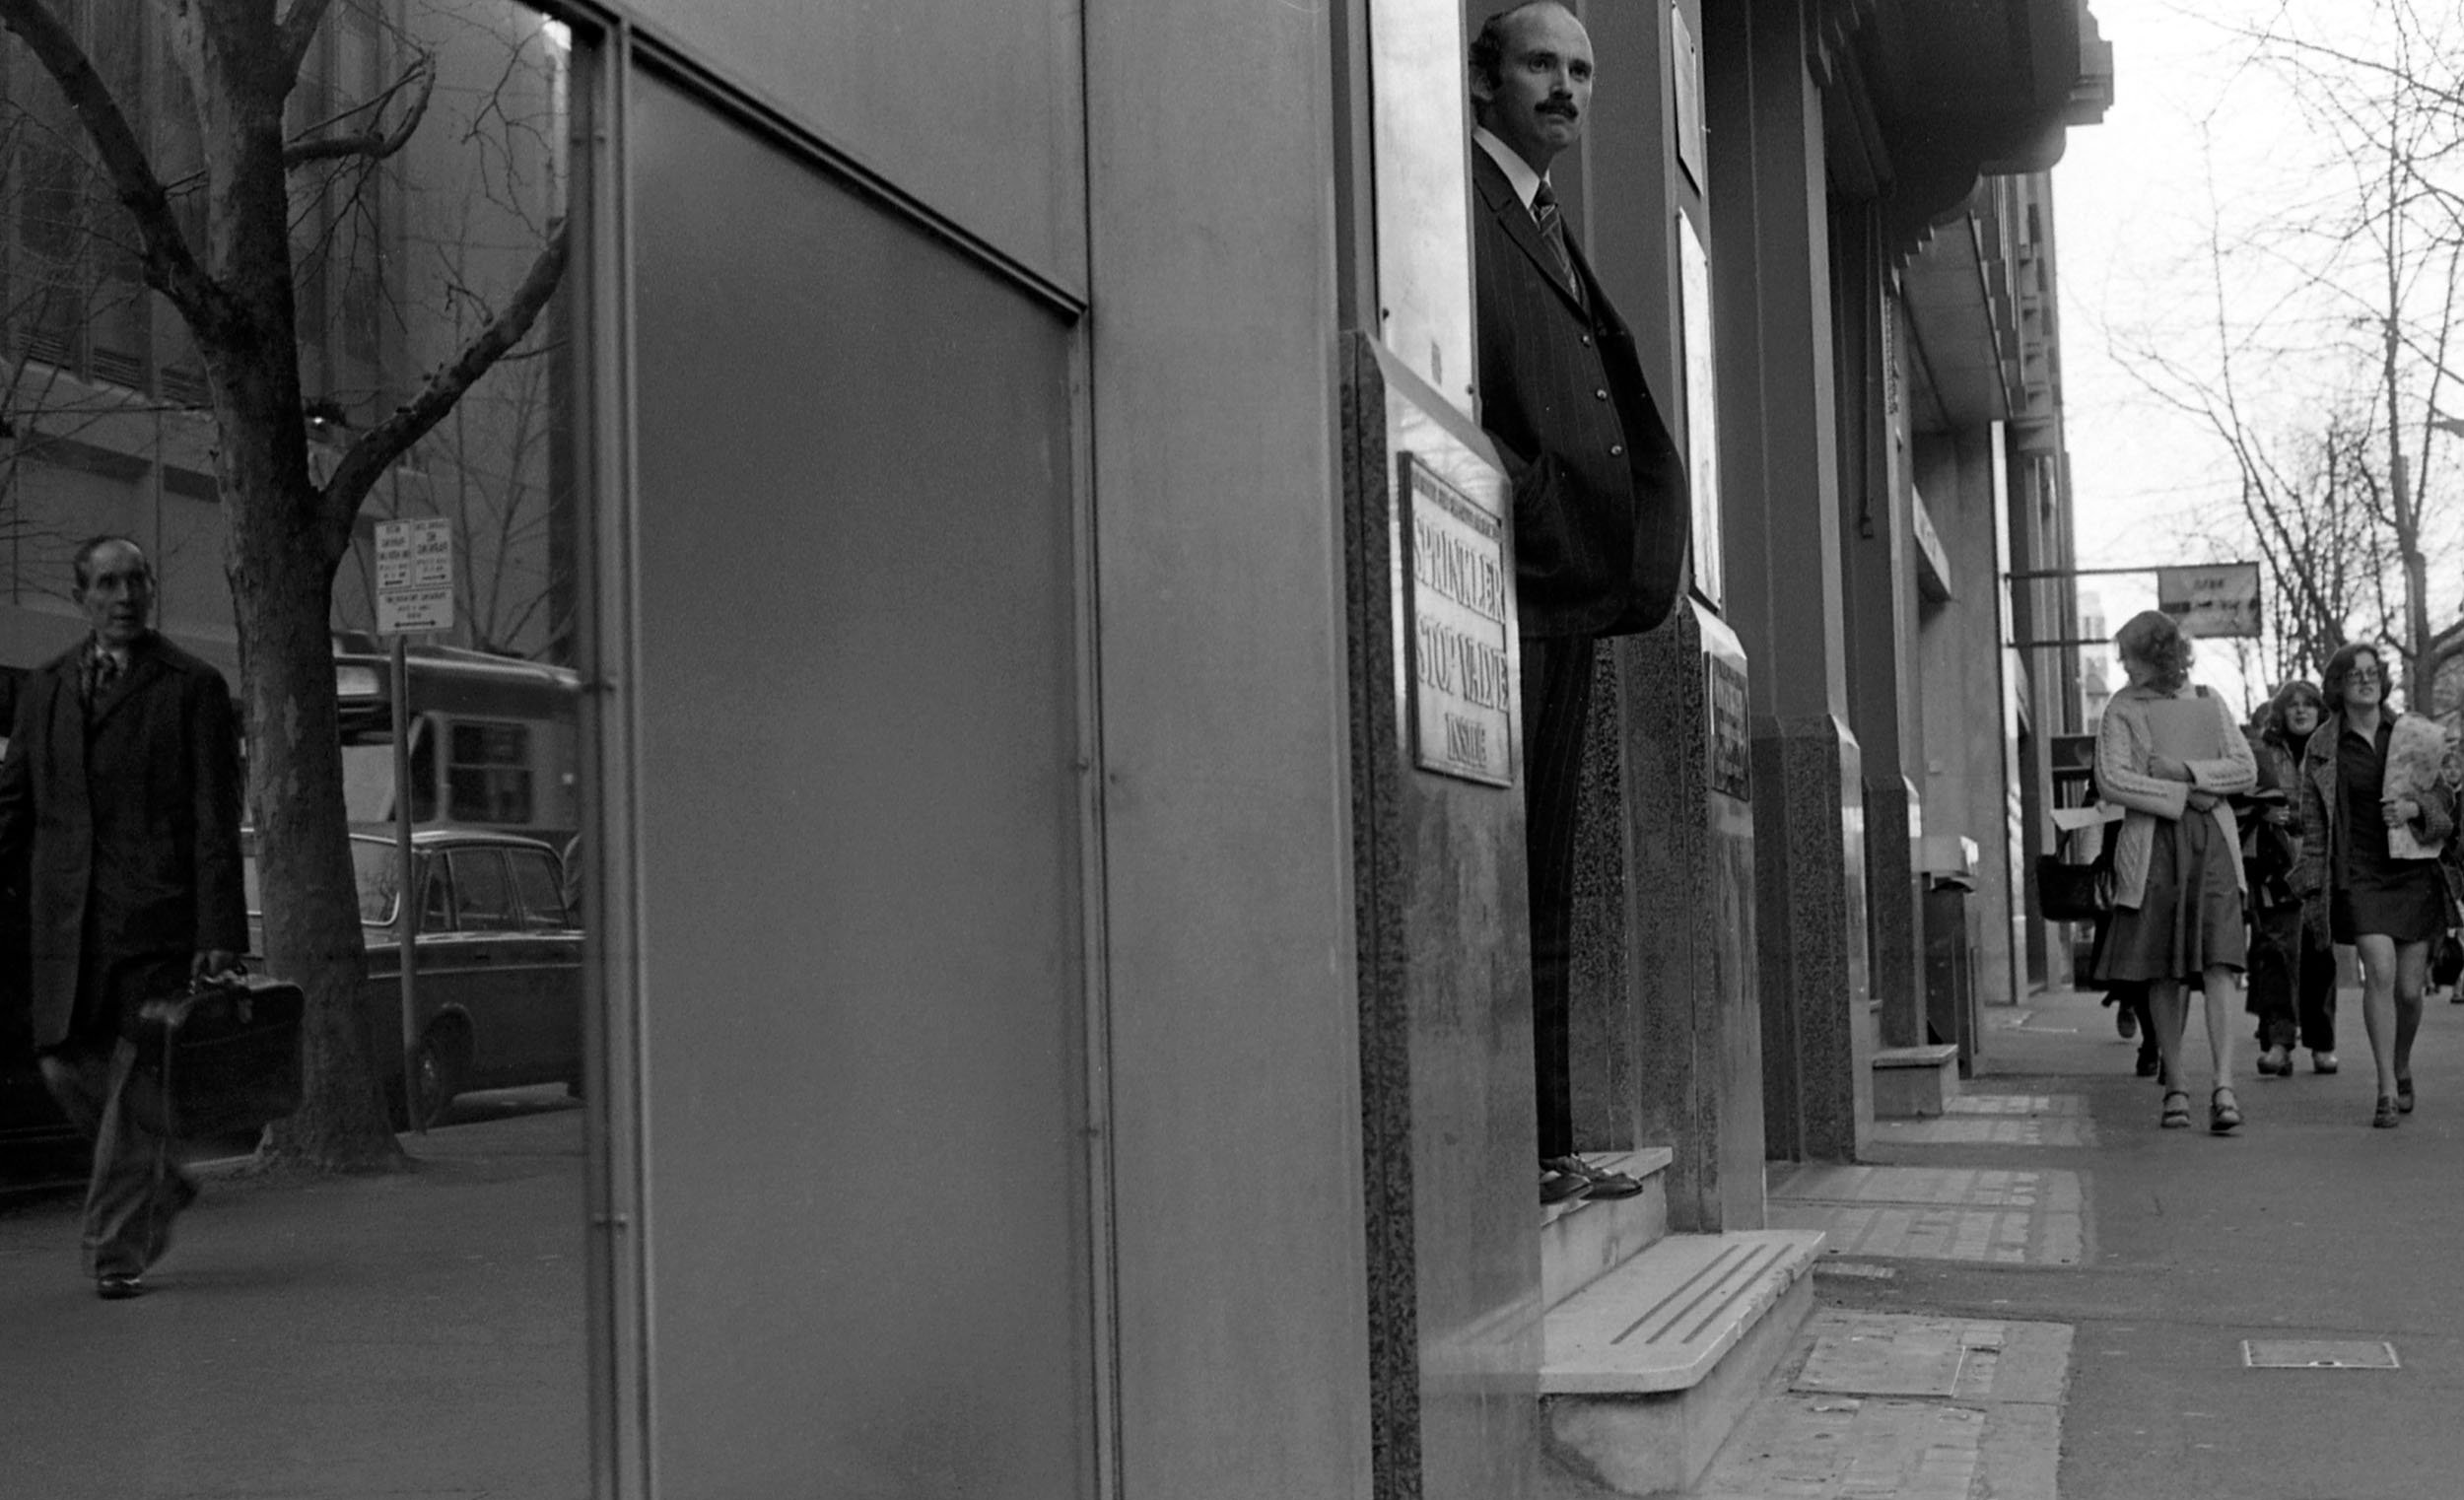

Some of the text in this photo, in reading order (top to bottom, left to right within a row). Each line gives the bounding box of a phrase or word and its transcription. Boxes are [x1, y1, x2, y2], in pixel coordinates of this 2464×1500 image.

[1413, 516, 1504, 624] SPRINKLER
[1415, 611, 1509, 714] STOP VALVE
[1445, 712, 1487, 769] INSIDE
